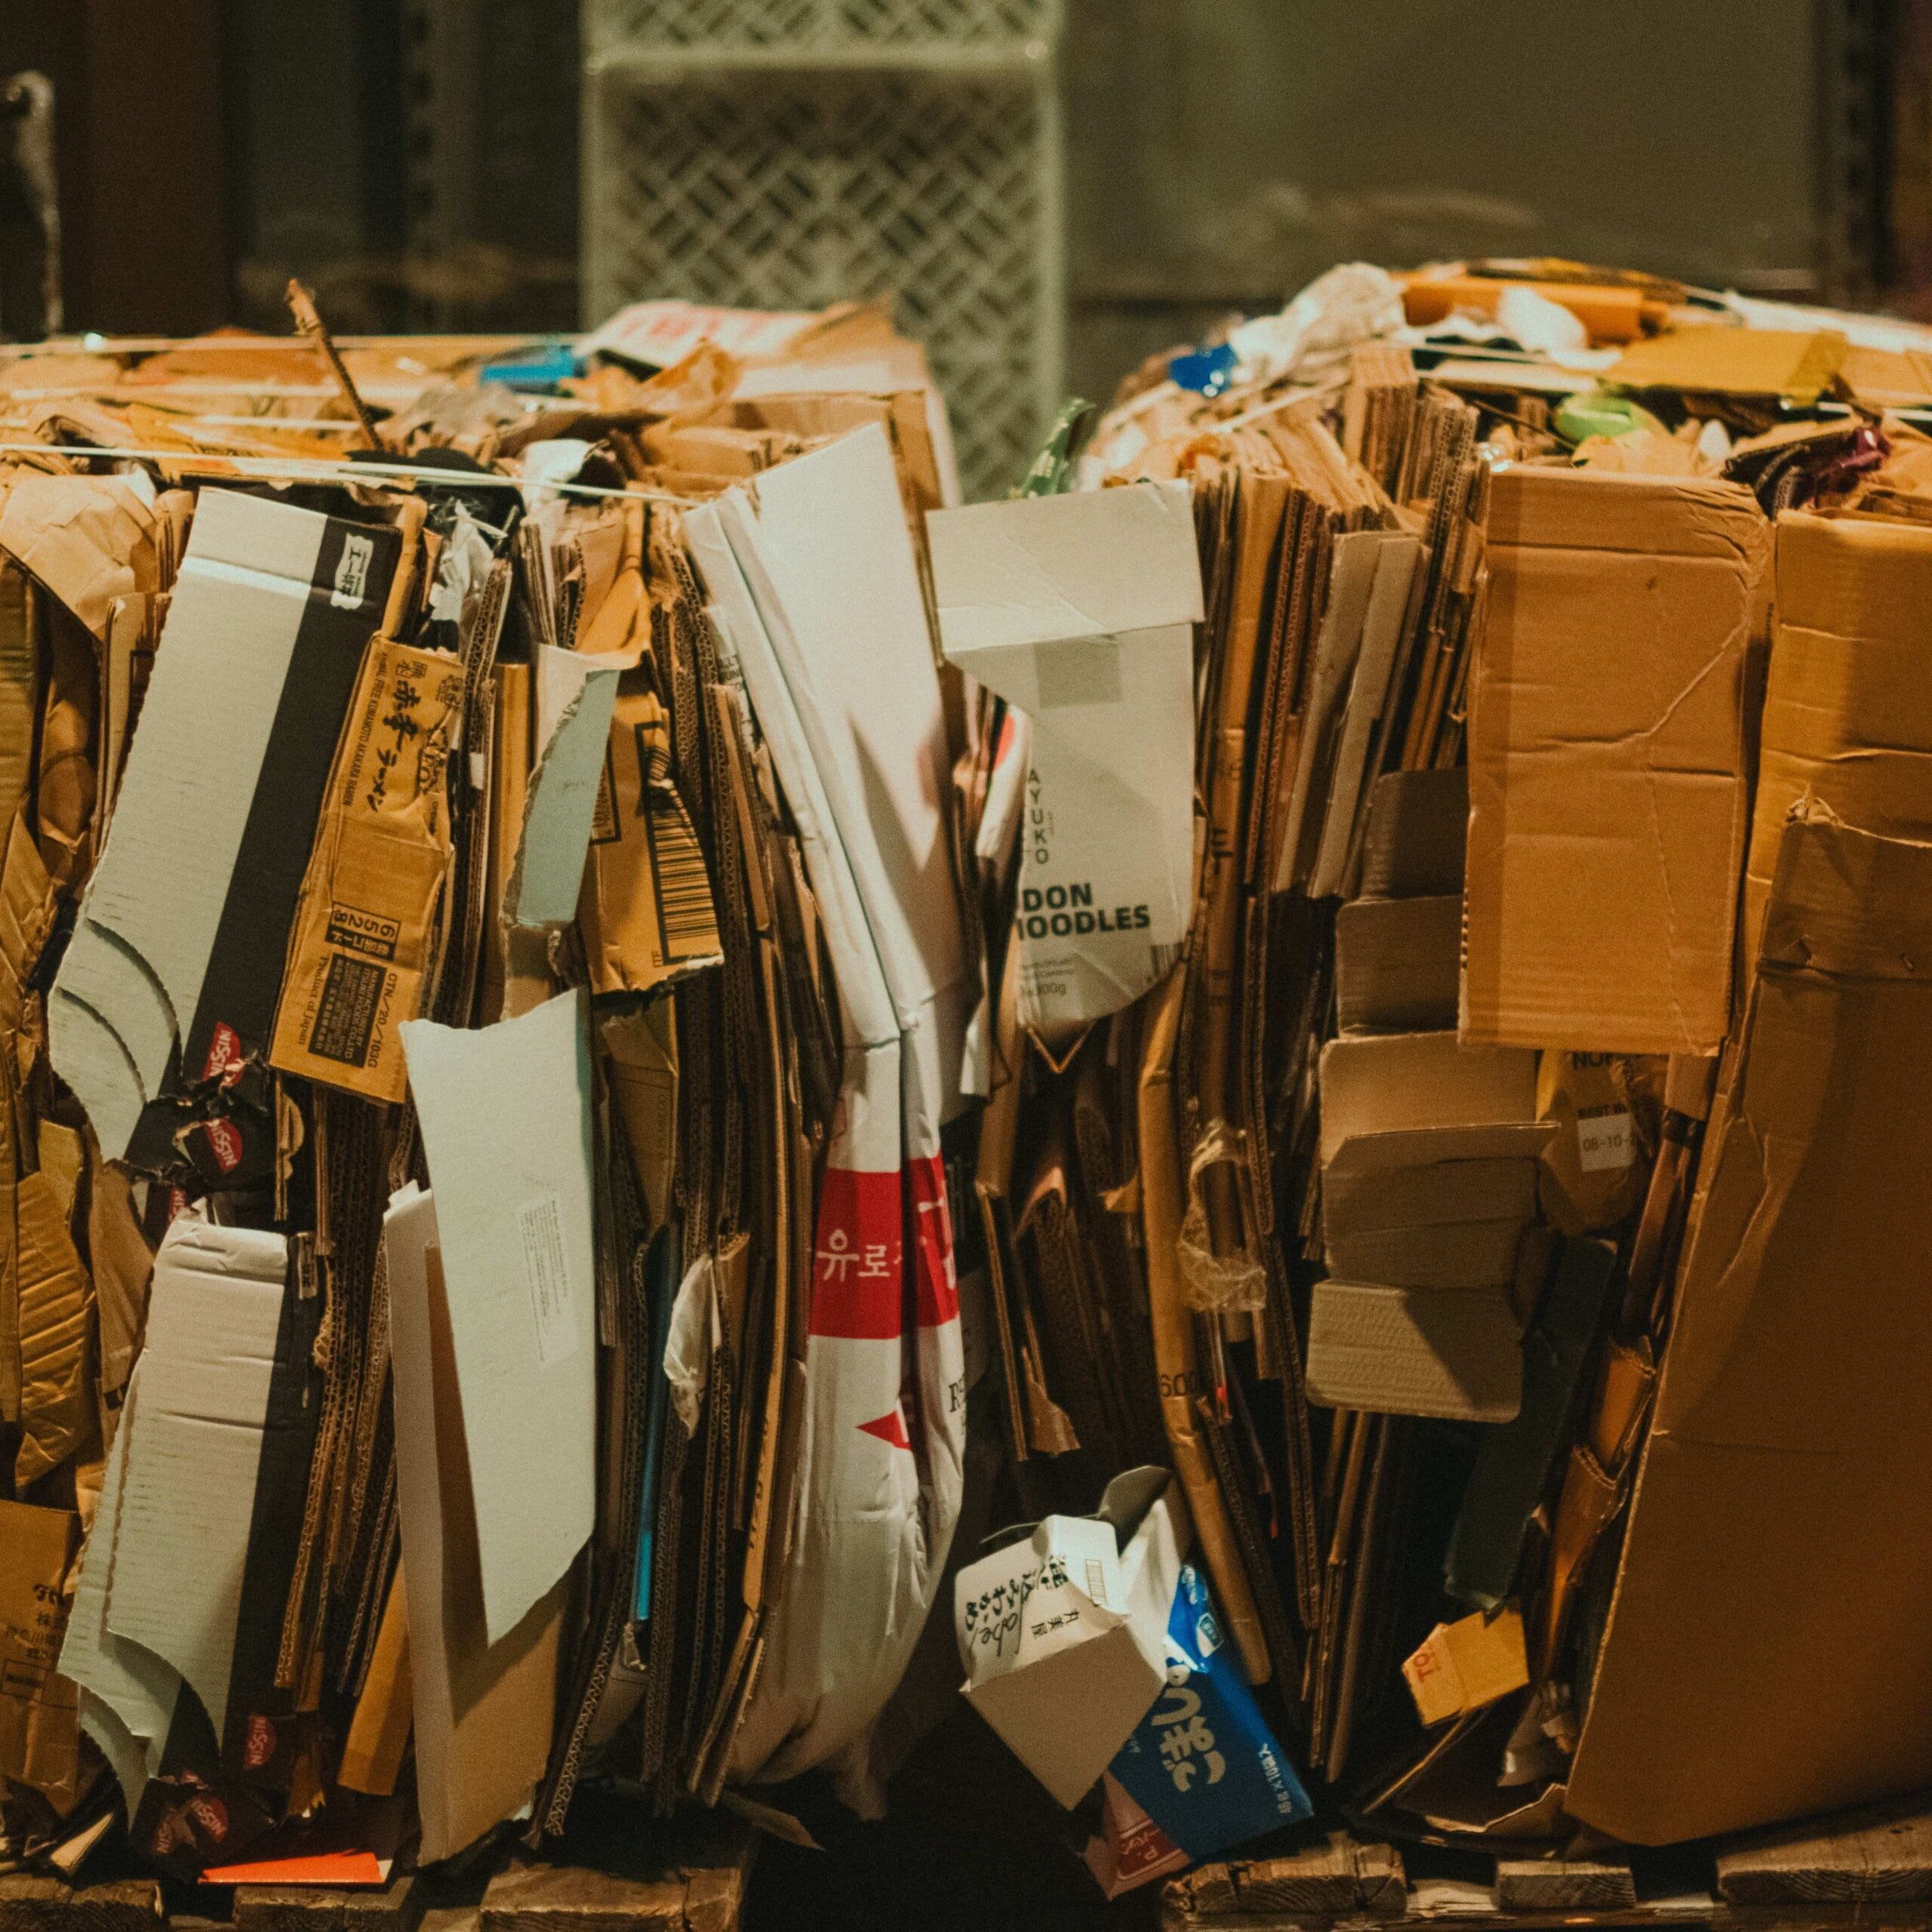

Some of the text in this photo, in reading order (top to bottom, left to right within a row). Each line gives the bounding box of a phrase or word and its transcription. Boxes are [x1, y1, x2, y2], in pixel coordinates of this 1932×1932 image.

[370, 678, 384, 699] FREE
[358, 698, 379, 743] KUMAMOTO
[349, 741, 367, 779] AKAKARA
[341, 778, 357, 807] RAMEN
[1023, 882, 1094, 912] DON
[295, 955, 330, 1046] Product of Japan
[350, 995, 365, 1025] FOODS
[815, 1228, 903, 1282] 유로
